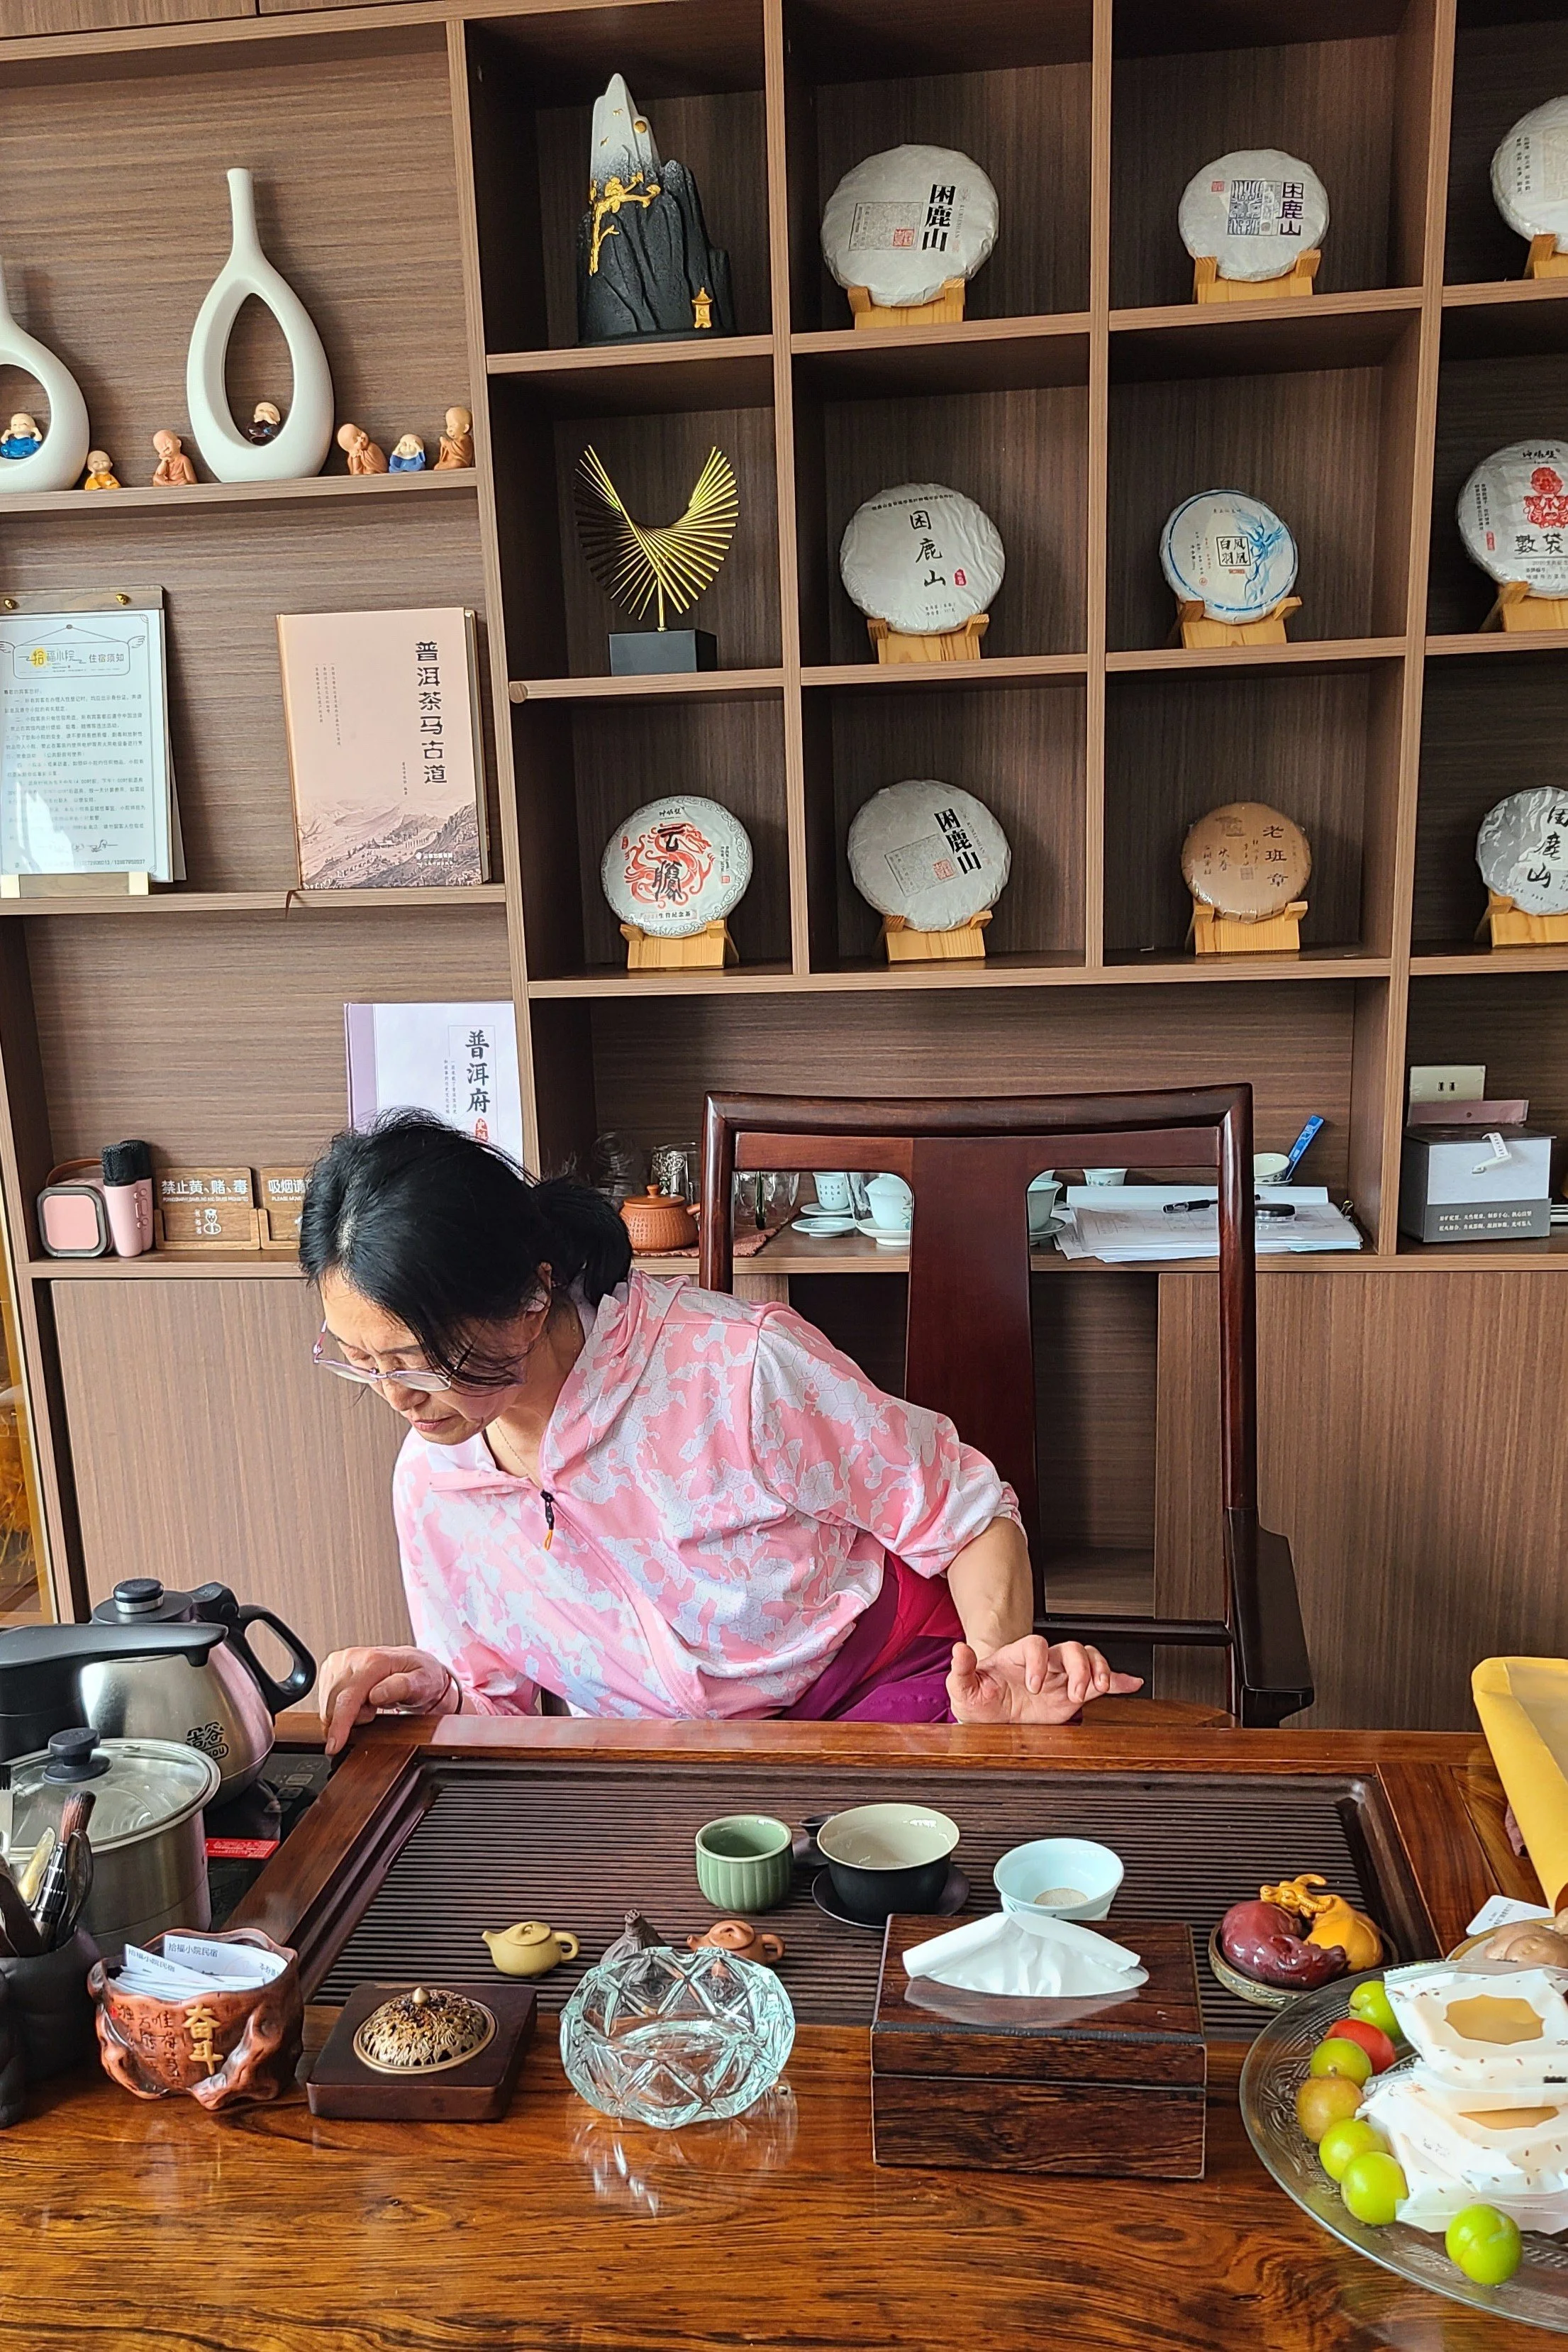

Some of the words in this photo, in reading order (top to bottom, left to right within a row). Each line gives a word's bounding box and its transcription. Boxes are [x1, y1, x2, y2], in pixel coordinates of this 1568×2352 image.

[922, 184, 956, 252] 困鹿山
[1277, 182, 1303, 235] 困鹿山
[909, 510, 946, 587] 困鹿山
[89, 653, 125, 664] 住宿须知
[415, 640, 447, 784] 普洱茶马古道
[933, 808, 982, 875] 困鹿山
[1262, 825, 1289, 887] 老班章
[465, 1029, 491, 1114] 普洱府
[161, 1180, 248, 1195] 禁止黄、赌、毒
[128, 1948, 175, 1973] 拾福小院民宿
[168, 1942, 218, 1958] 拾福小院民宿
[182, 2004, 224, 2075] 奋斗
